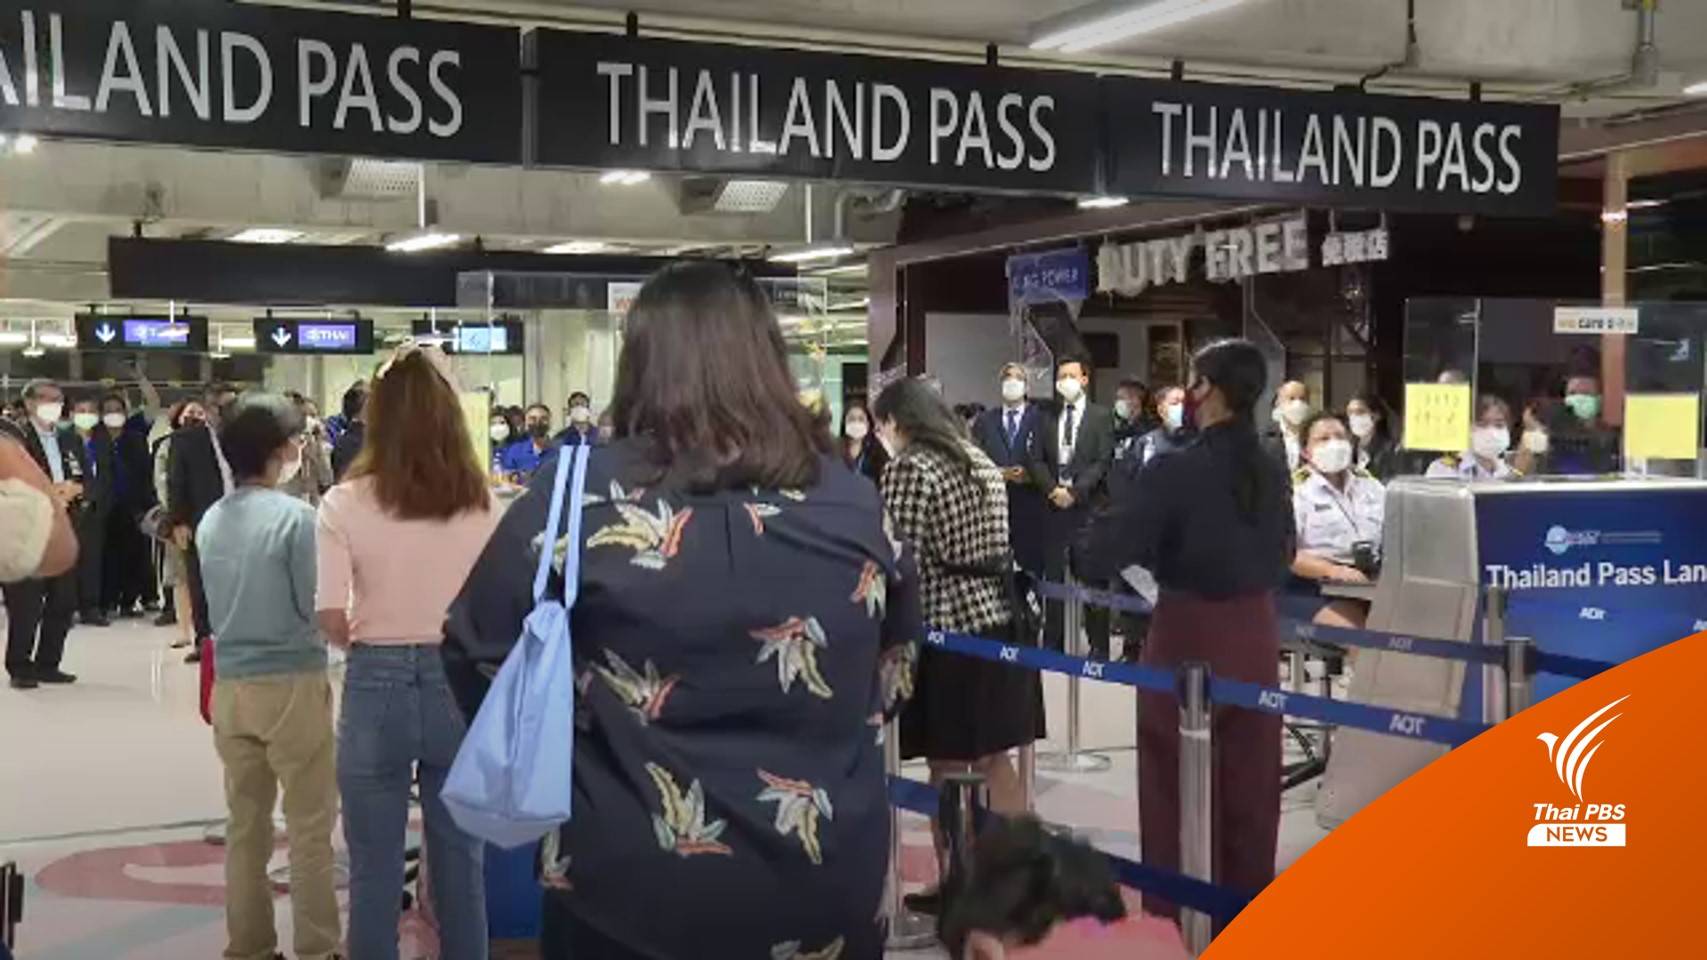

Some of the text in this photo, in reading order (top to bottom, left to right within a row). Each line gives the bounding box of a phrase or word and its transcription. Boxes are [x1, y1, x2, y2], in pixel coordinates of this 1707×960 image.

[298, 38, 463, 138] PASS
[597, 61, 1057, 172] THAILAND PASS
[1152, 102, 1523, 195] THAILAND PASS
[1097, 219, 1309, 298] DUTY FREE
[1485, 562, 1590, 589] Thailand
[1597, 561, 1657, 586] Pass
[1082, 660, 1106, 678] AOT
[1258, 689, 1290, 711] AOT
[1389, 713, 1427, 737] AOT
